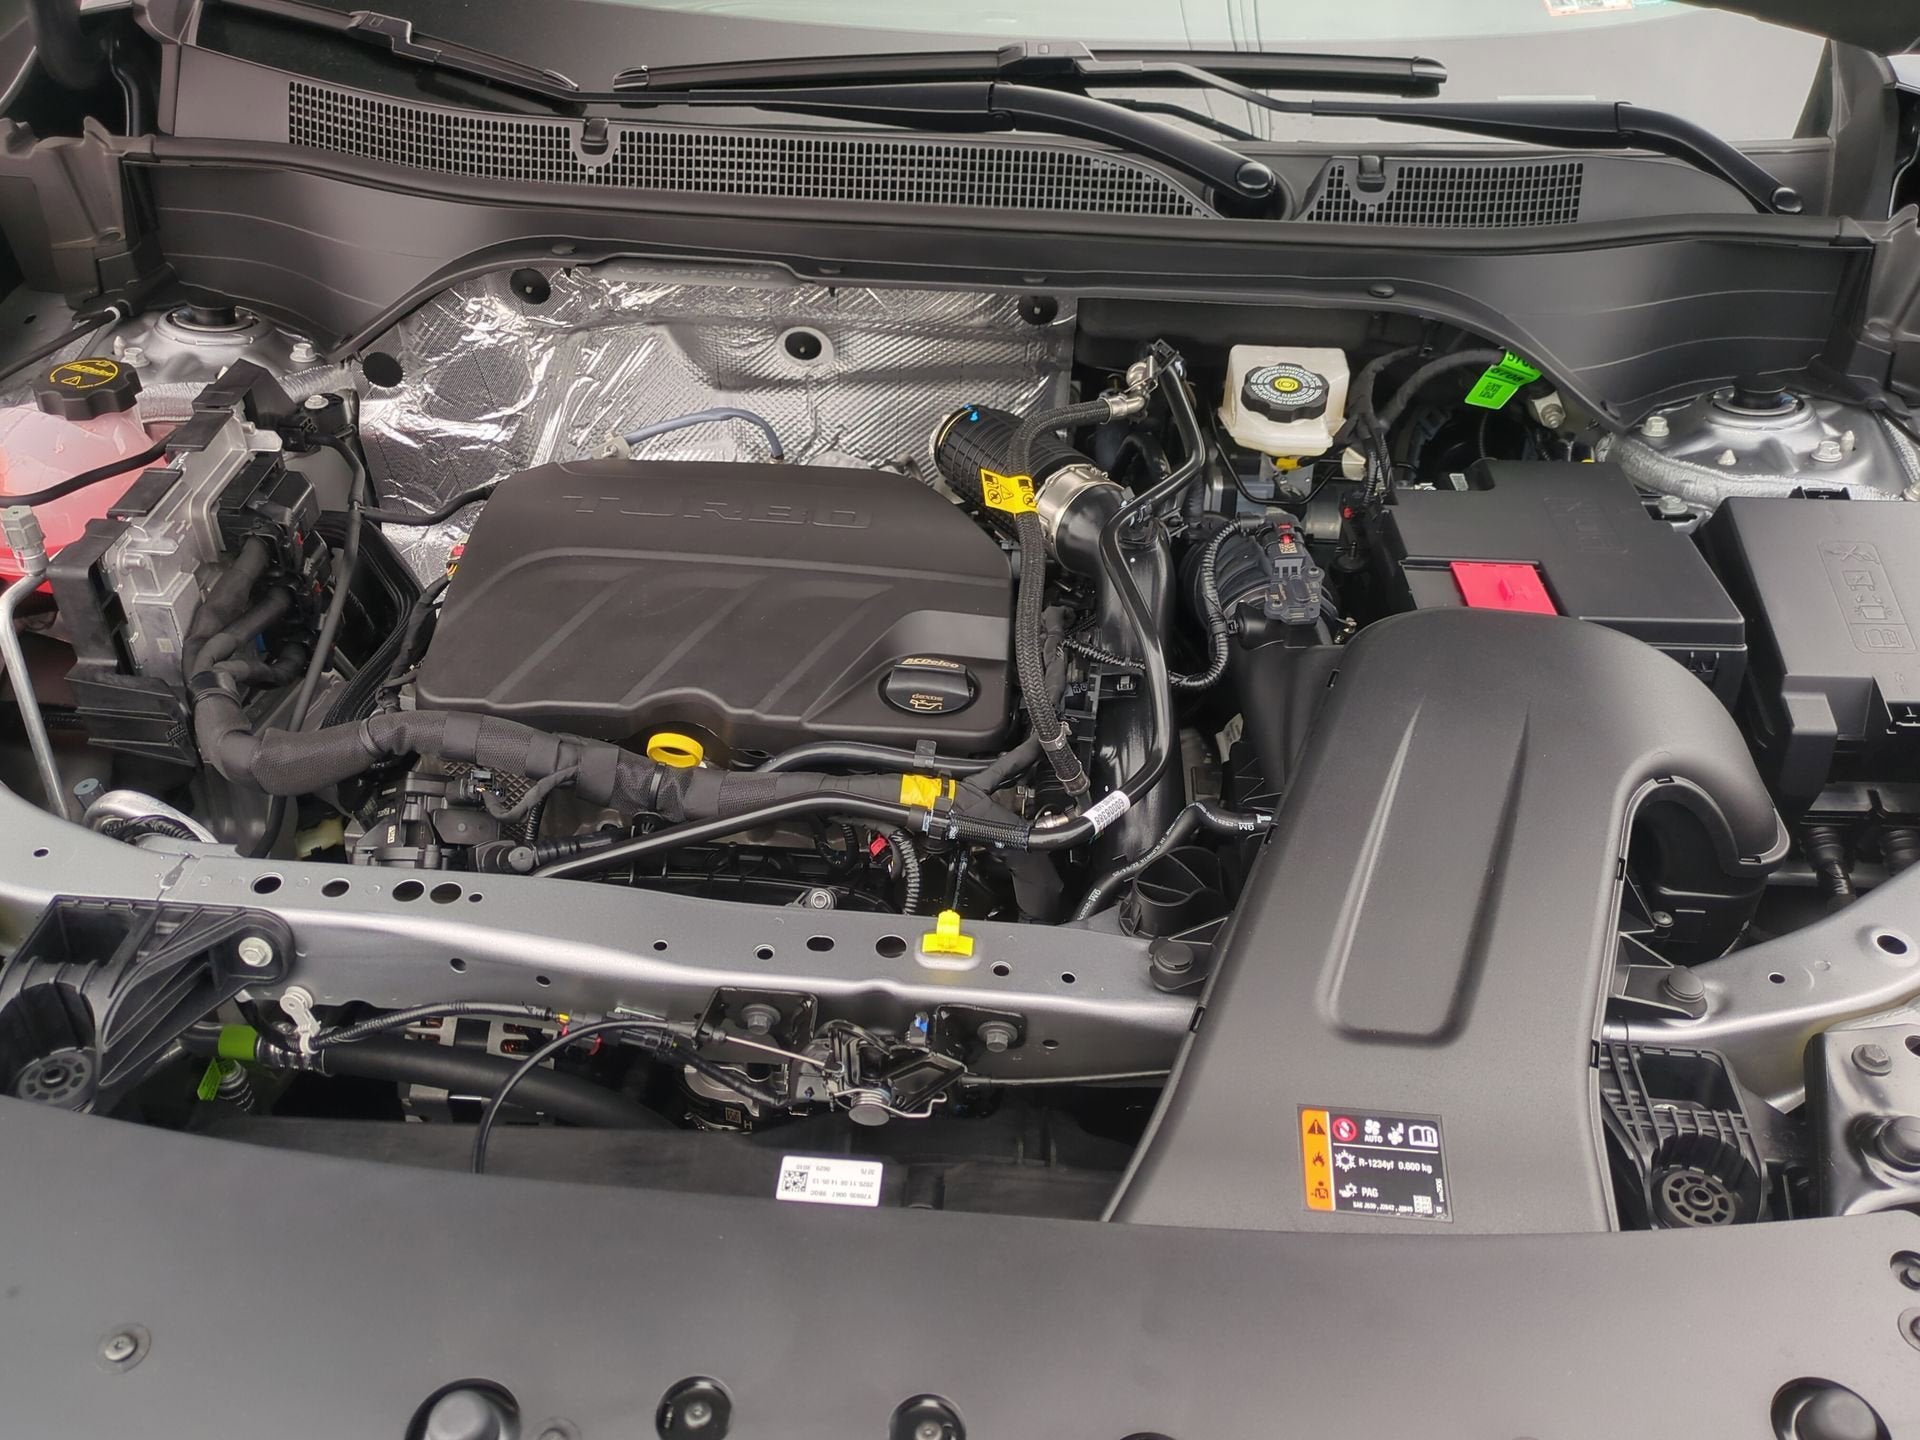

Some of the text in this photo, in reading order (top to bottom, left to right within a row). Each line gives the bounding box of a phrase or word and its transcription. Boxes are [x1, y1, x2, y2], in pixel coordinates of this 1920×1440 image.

[562, 495, 872, 529] TURBO
[901, 658, 960, 668] ACDelco
[1364, 1134, 1383, 1143] AUTO
[1359, 1158, 1394, 1171] R-1234yf
[1422, 1163, 1433, 1174] kg
[1361, 1187, 1379, 1198] PAG
